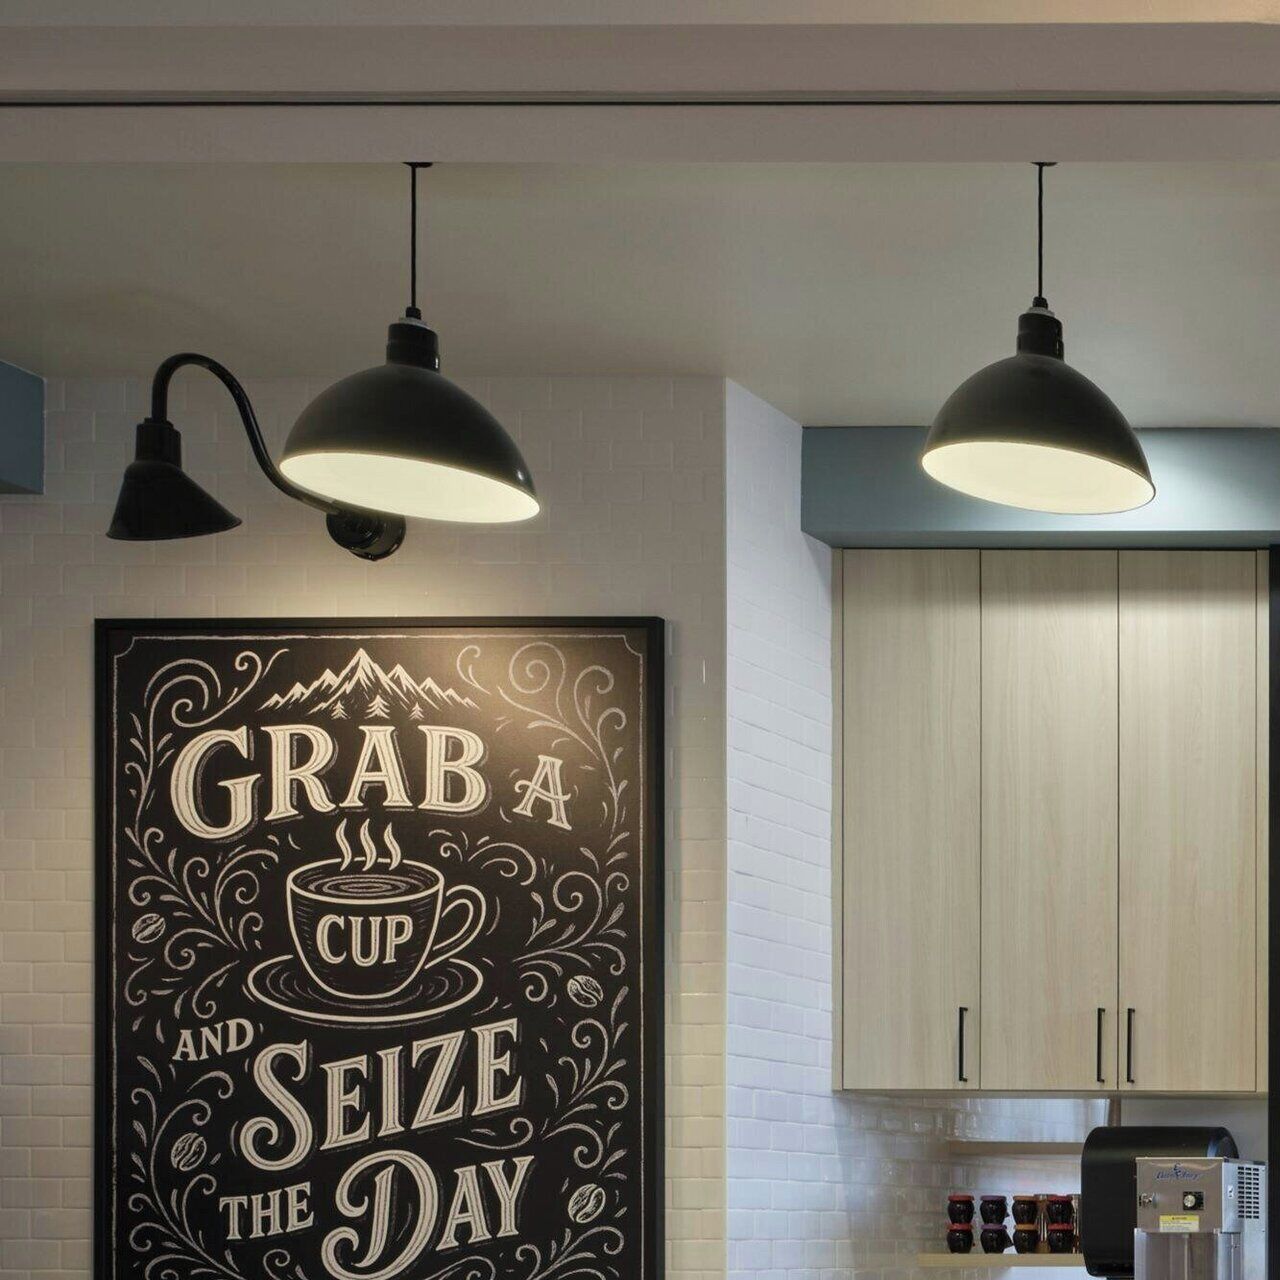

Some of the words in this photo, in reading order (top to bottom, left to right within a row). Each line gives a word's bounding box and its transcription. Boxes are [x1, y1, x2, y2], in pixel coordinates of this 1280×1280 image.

[171, 725, 490, 840] GRAB
[513, 755, 572, 831] A
[316, 914, 413, 968] CUP
[173, 1017, 254, 1062] AND
[240, 1017, 521, 1172] SEIZE
[219, 1183, 315, 1241] THE
